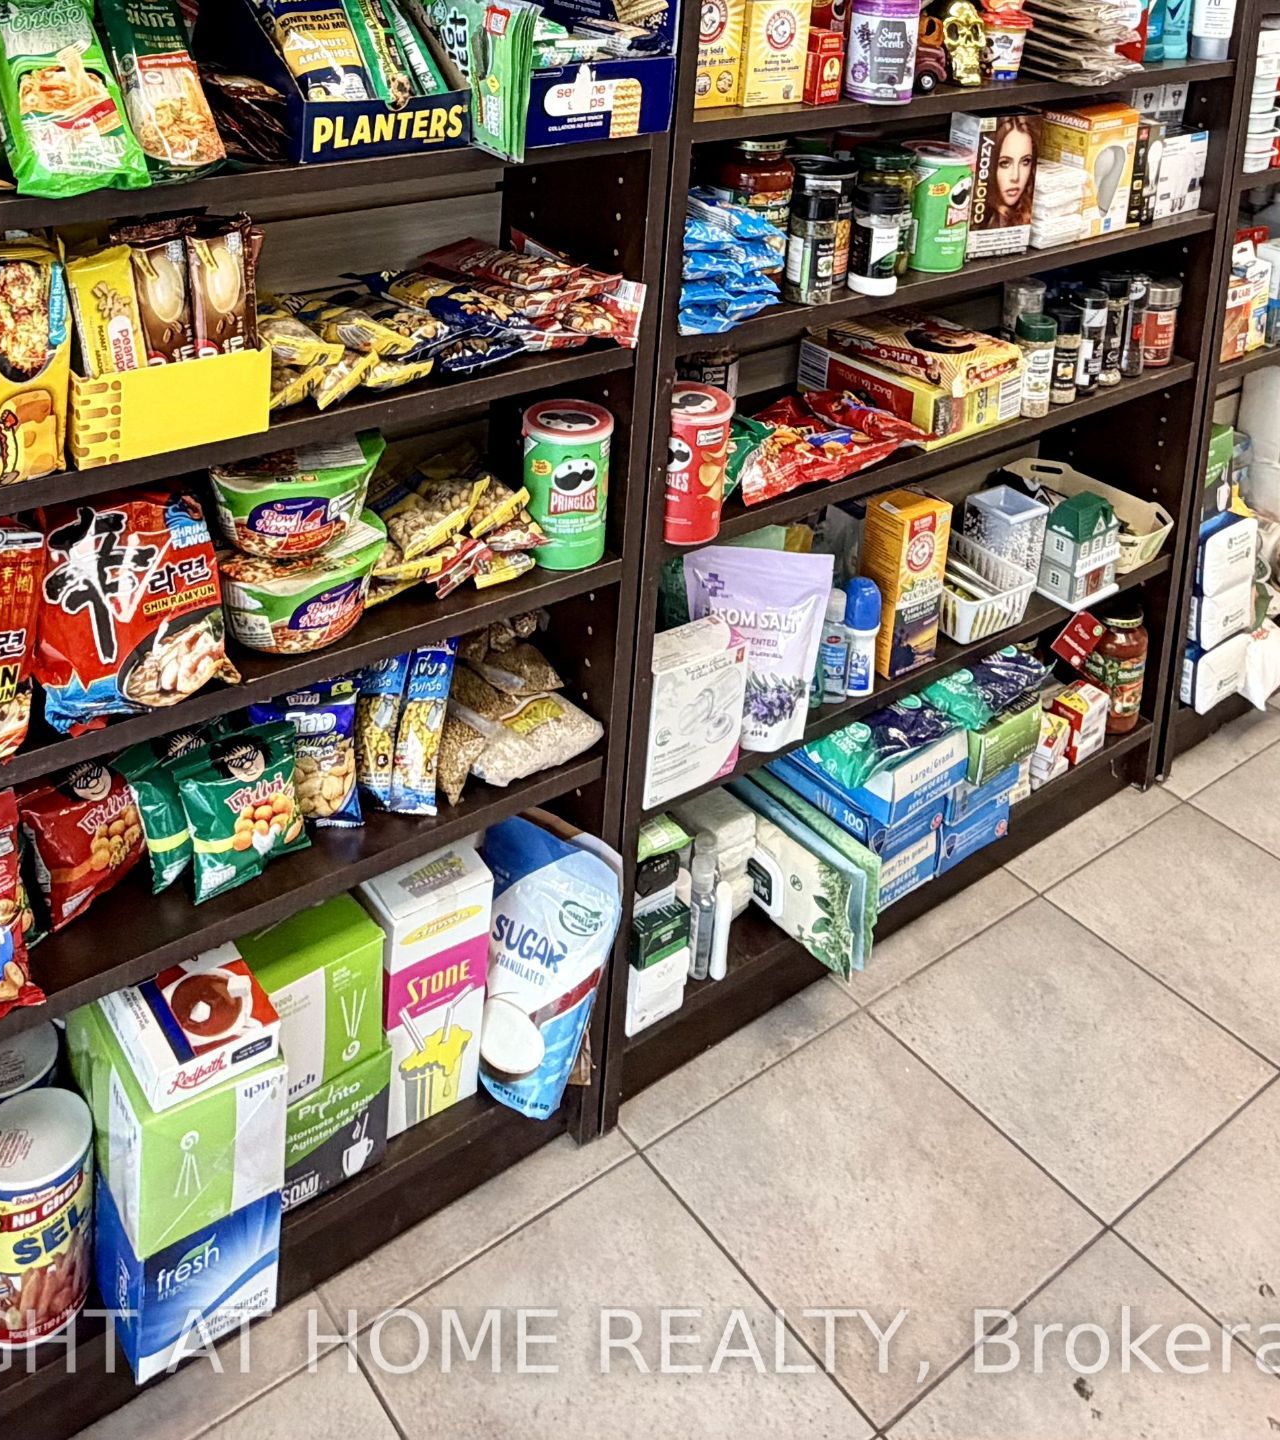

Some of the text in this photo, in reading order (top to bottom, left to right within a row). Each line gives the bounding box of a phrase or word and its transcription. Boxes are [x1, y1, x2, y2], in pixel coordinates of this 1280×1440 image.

[312, 105, 464, 153] PLANTERS
[1046, 111, 1090, 130] SYLVANIA
[879, 346, 919, 367] Parle-G
[263, 510, 297, 526] Bowl
[550, 491, 597, 513] PRINGLES
[148, 556, 211, 594] 라면
[144, 584, 216, 614] SHIN RAMYUN
[842, 809, 865, 833] 100
[492, 914, 568, 973] SUGAR
[406, 960, 470, 1007] STONE
[496, 951, 546, 986] GRANULATED
[167, 1054, 227, 1095] Redpath
[11, 1208, 38, 1227] Nu
[156, 1243, 222, 1293] fresh
